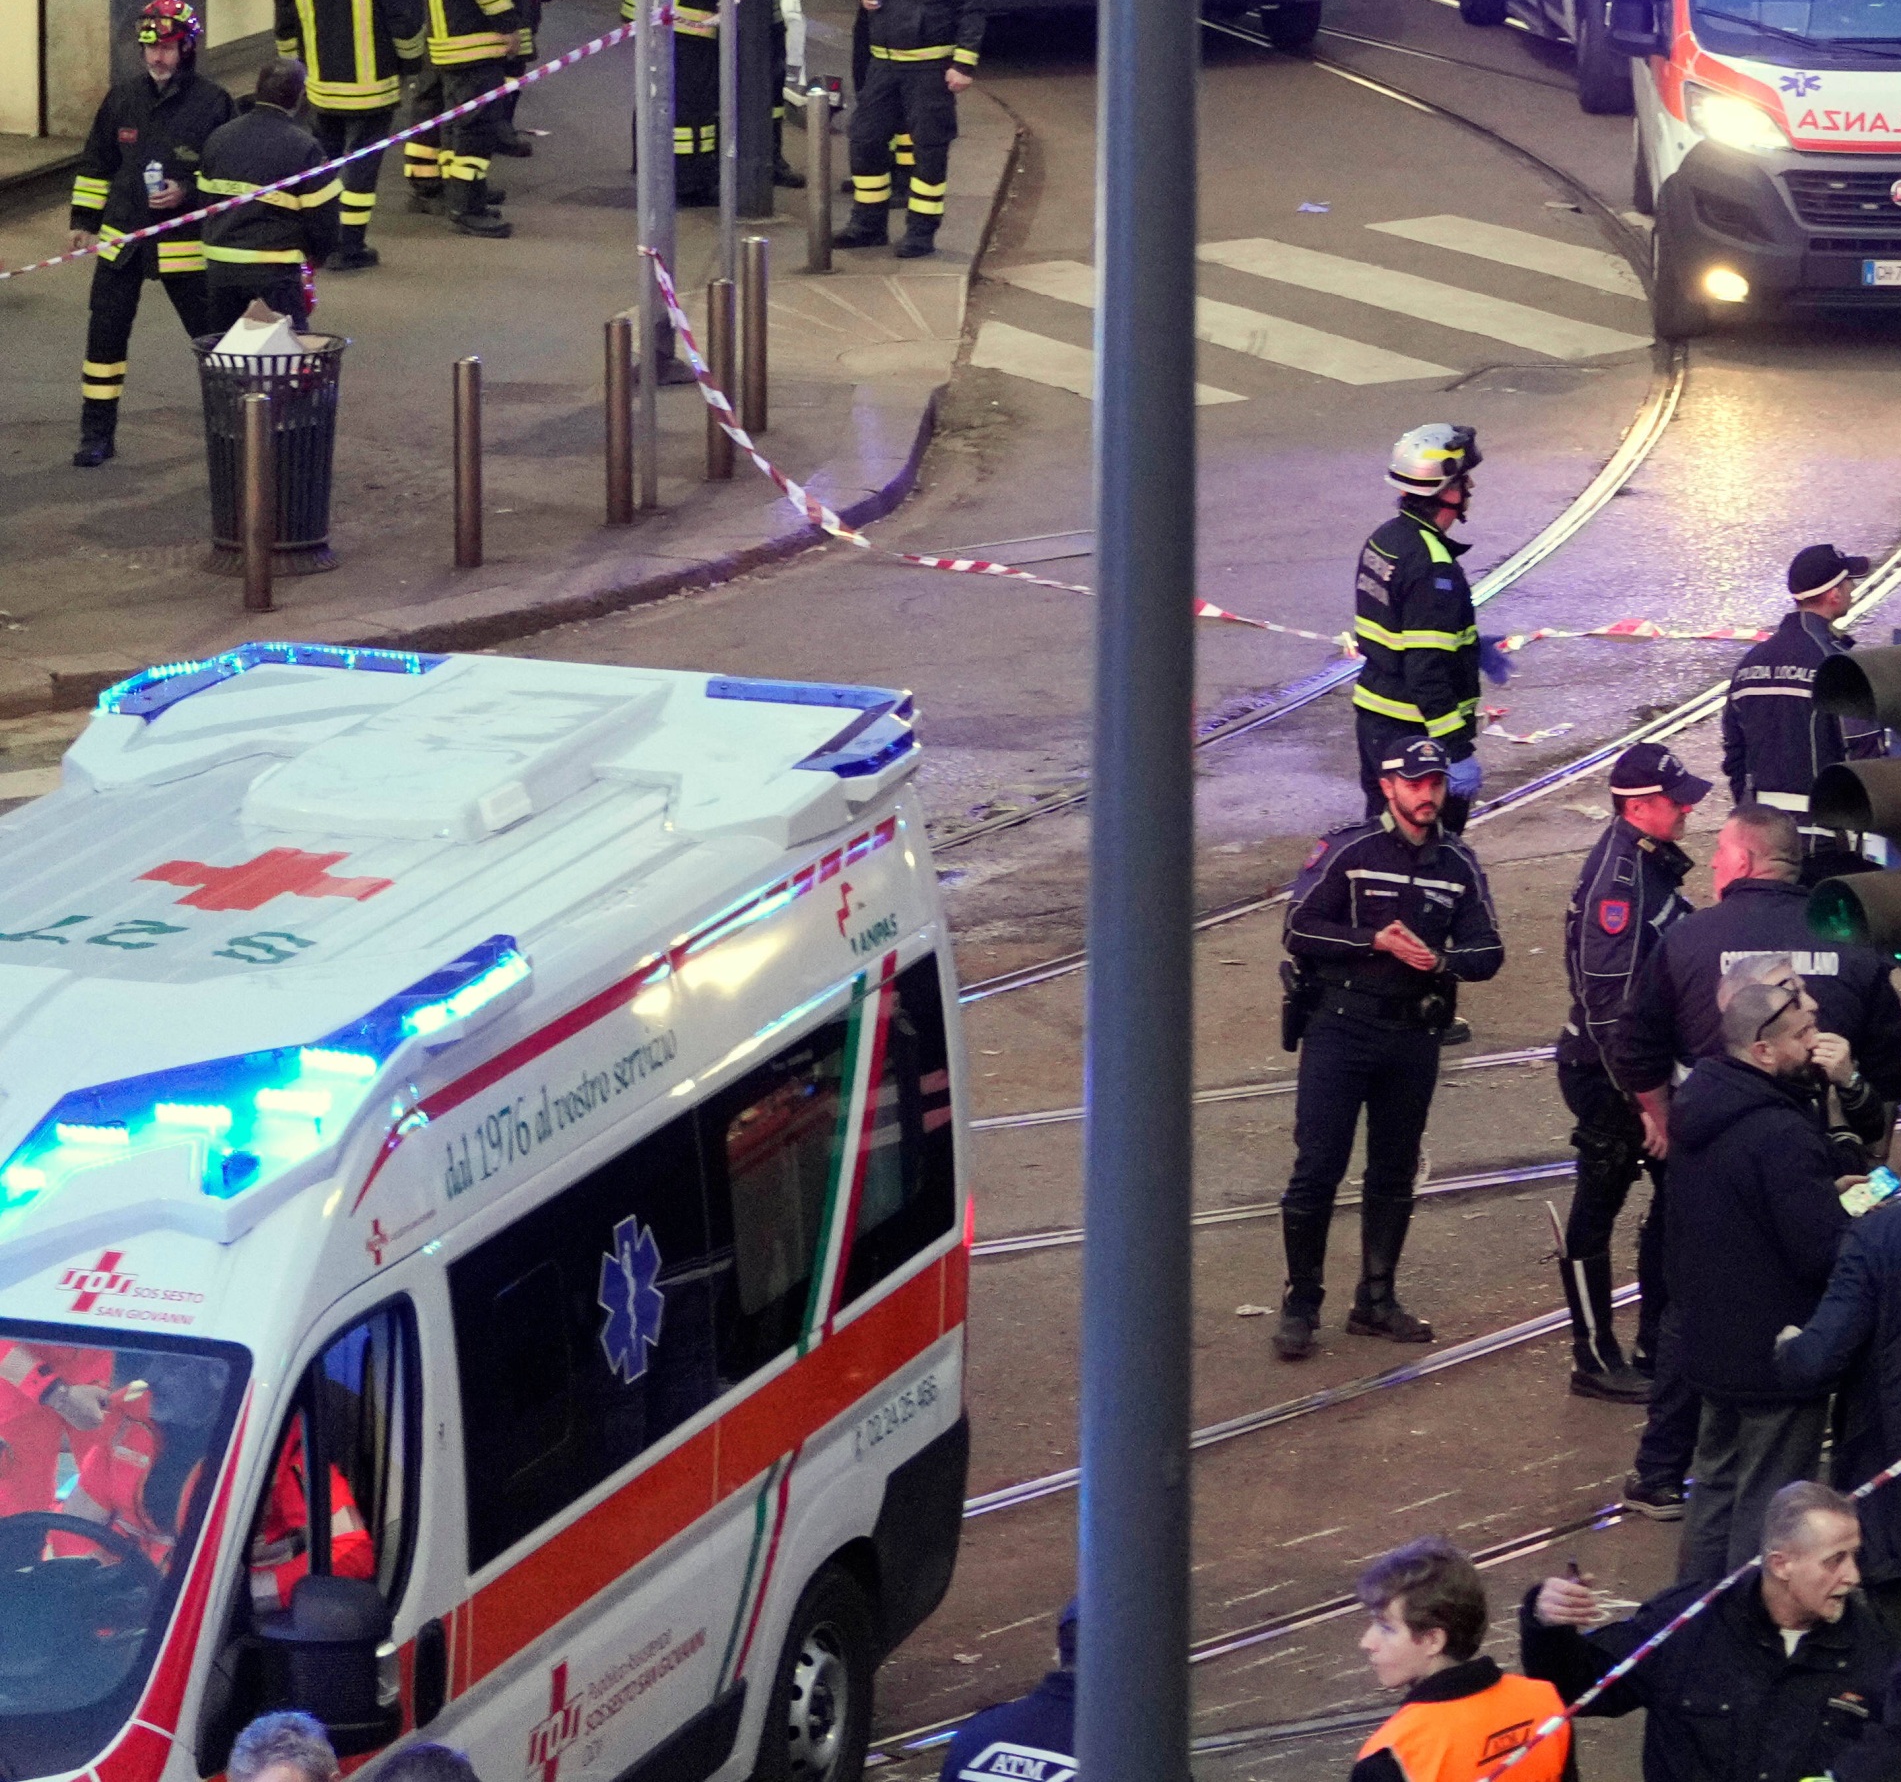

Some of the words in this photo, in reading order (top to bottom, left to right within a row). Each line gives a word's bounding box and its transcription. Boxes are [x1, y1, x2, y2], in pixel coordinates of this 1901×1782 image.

[445, 1133, 474, 1201] dal
[476, 1096, 531, 1182] 1976
[536, 1084, 553, 1145] al
[132, 1285, 160, 1300] SOS
[161, 1289, 205, 1305] SESTO
[95, 1305, 125, 1318] SAN
[126, 1307, 197, 1326] GIOVANNI
[989, 1754, 1046, 1781] ATM
